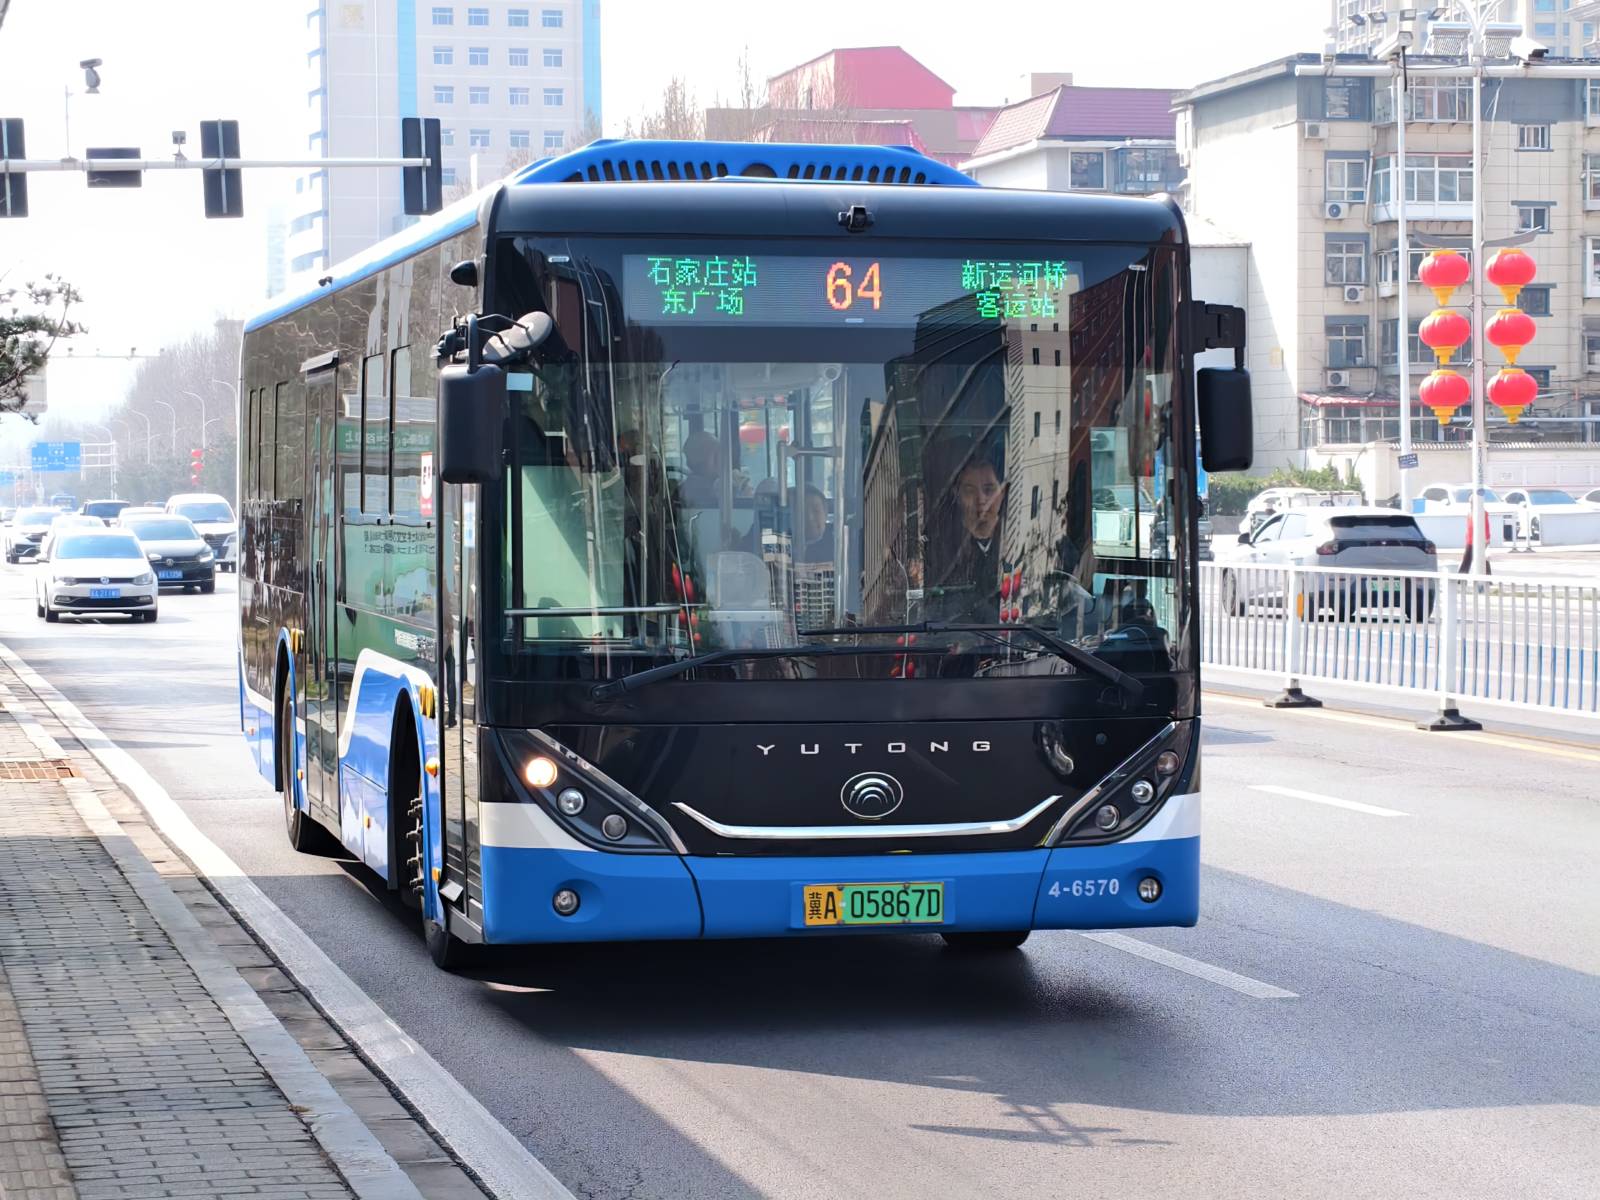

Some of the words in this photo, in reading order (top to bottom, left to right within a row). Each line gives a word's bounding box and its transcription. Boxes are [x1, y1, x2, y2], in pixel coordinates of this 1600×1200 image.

[647, 255, 757, 286] 石家庄站
[961, 259, 1068, 291] 新运河桥
[661, 284, 744, 315] 东广场
[826, 262, 882, 311] 64
[976, 290, 1056, 319] 客运站
[756, 740, 991, 756] YUTONG
[850, 888, 941, 918] 05867D
[1048, 878, 1120, 898] 4-6570
